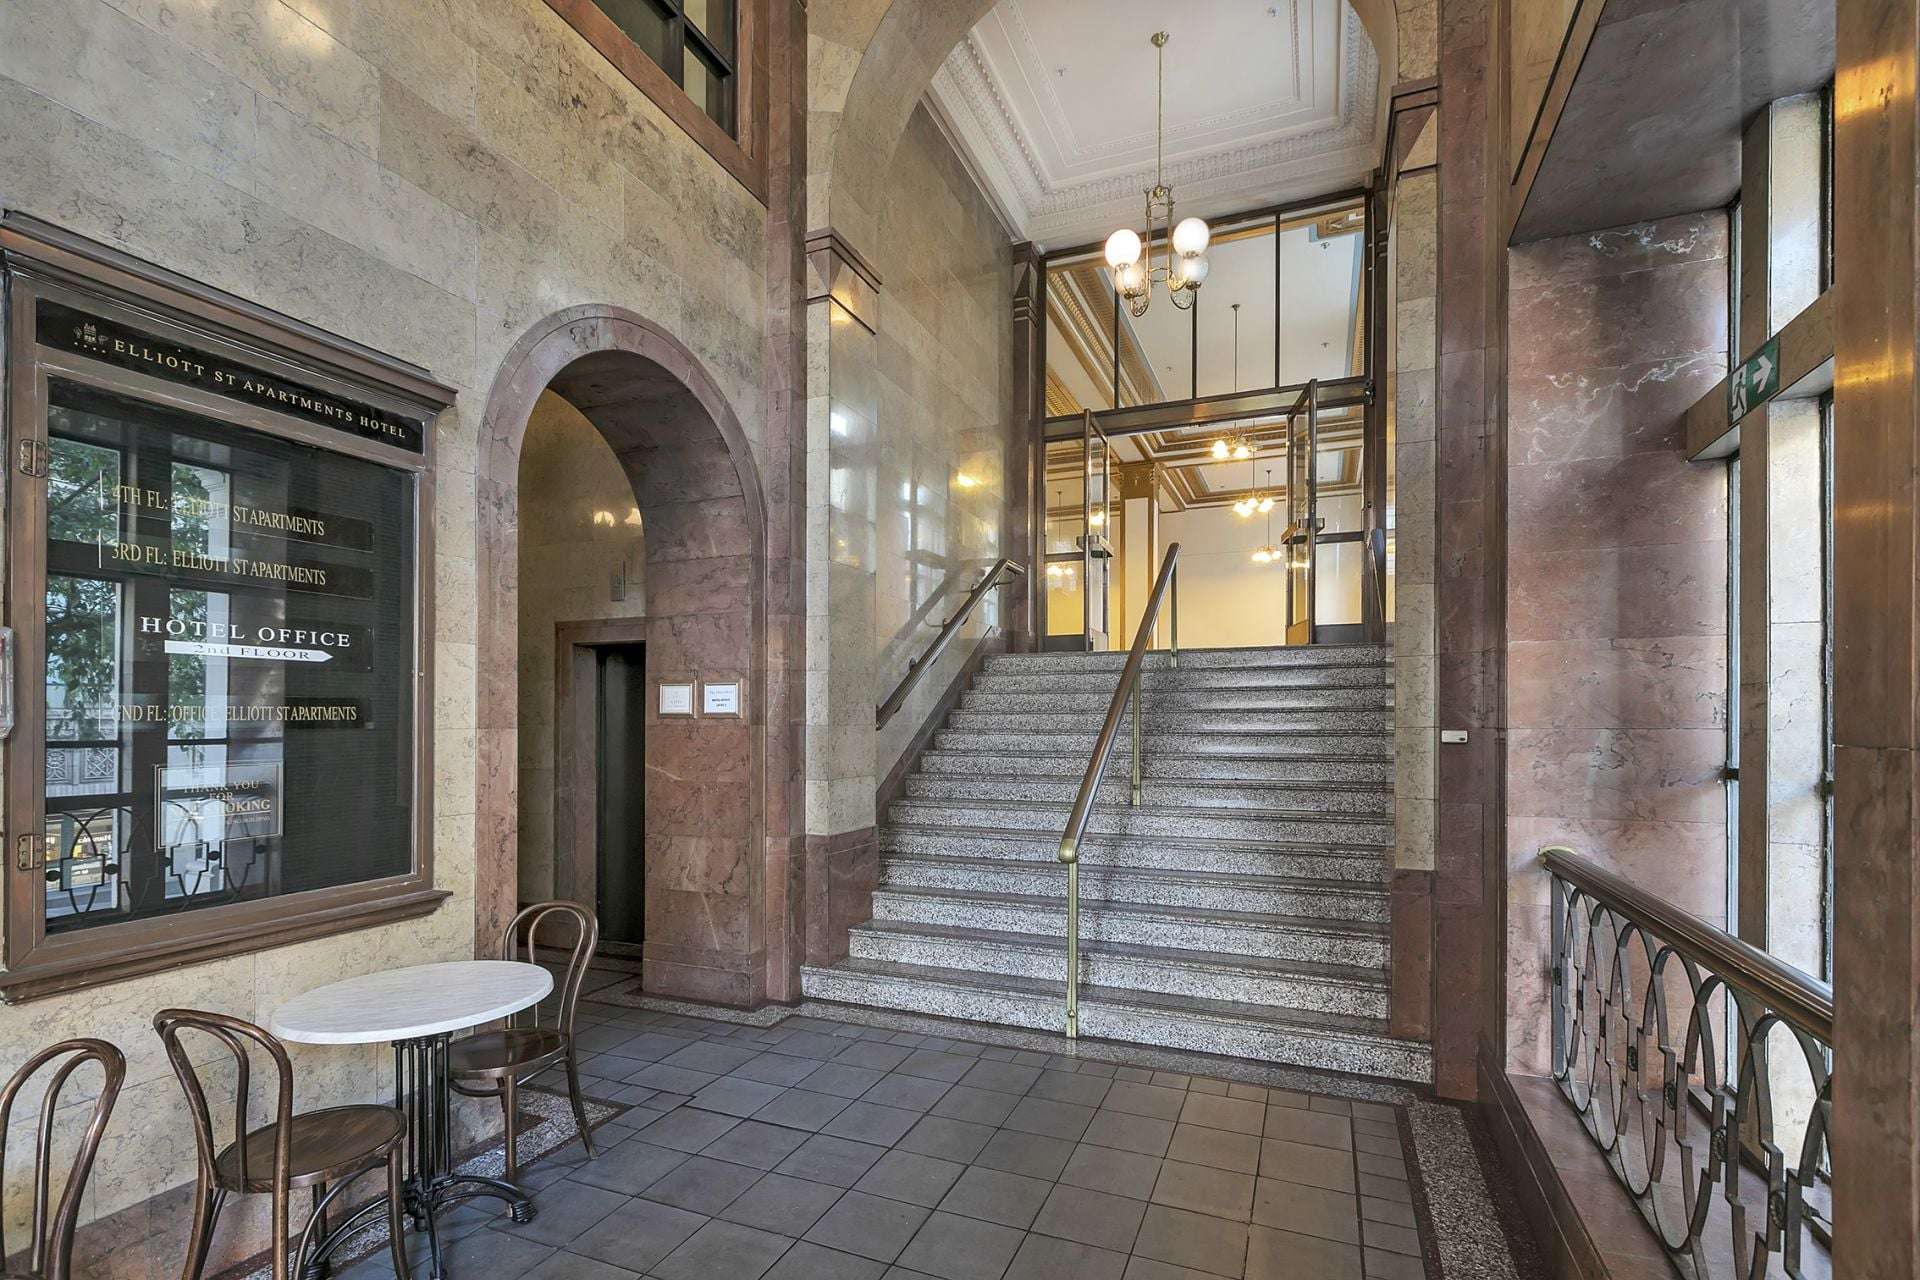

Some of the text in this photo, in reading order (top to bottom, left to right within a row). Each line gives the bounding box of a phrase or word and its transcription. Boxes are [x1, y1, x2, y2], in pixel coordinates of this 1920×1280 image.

[114, 339, 407, 439] ELLIOTT ST APARTMENTS HOTEL
[112, 484, 142, 506] 4TH
[147, 490, 168, 510] FL:
[233, 505, 249, 524] ST
[249, 508, 325, 536] APARTMENTS
[111, 542, 326, 586] 3RD FL: ELLIOTT ST APARTMENTS
[139, 616, 351, 648] HOTEL OFFICE
[239, 646, 310, 660] FLOOR
[147, 704, 167, 722] FL:
[224, 704, 275, 722] ELLIOTT
[276, 705, 291, 721] ST
[290, 705, 357, 721] APARTMENTS
[233, 779, 260, 790] YOU
